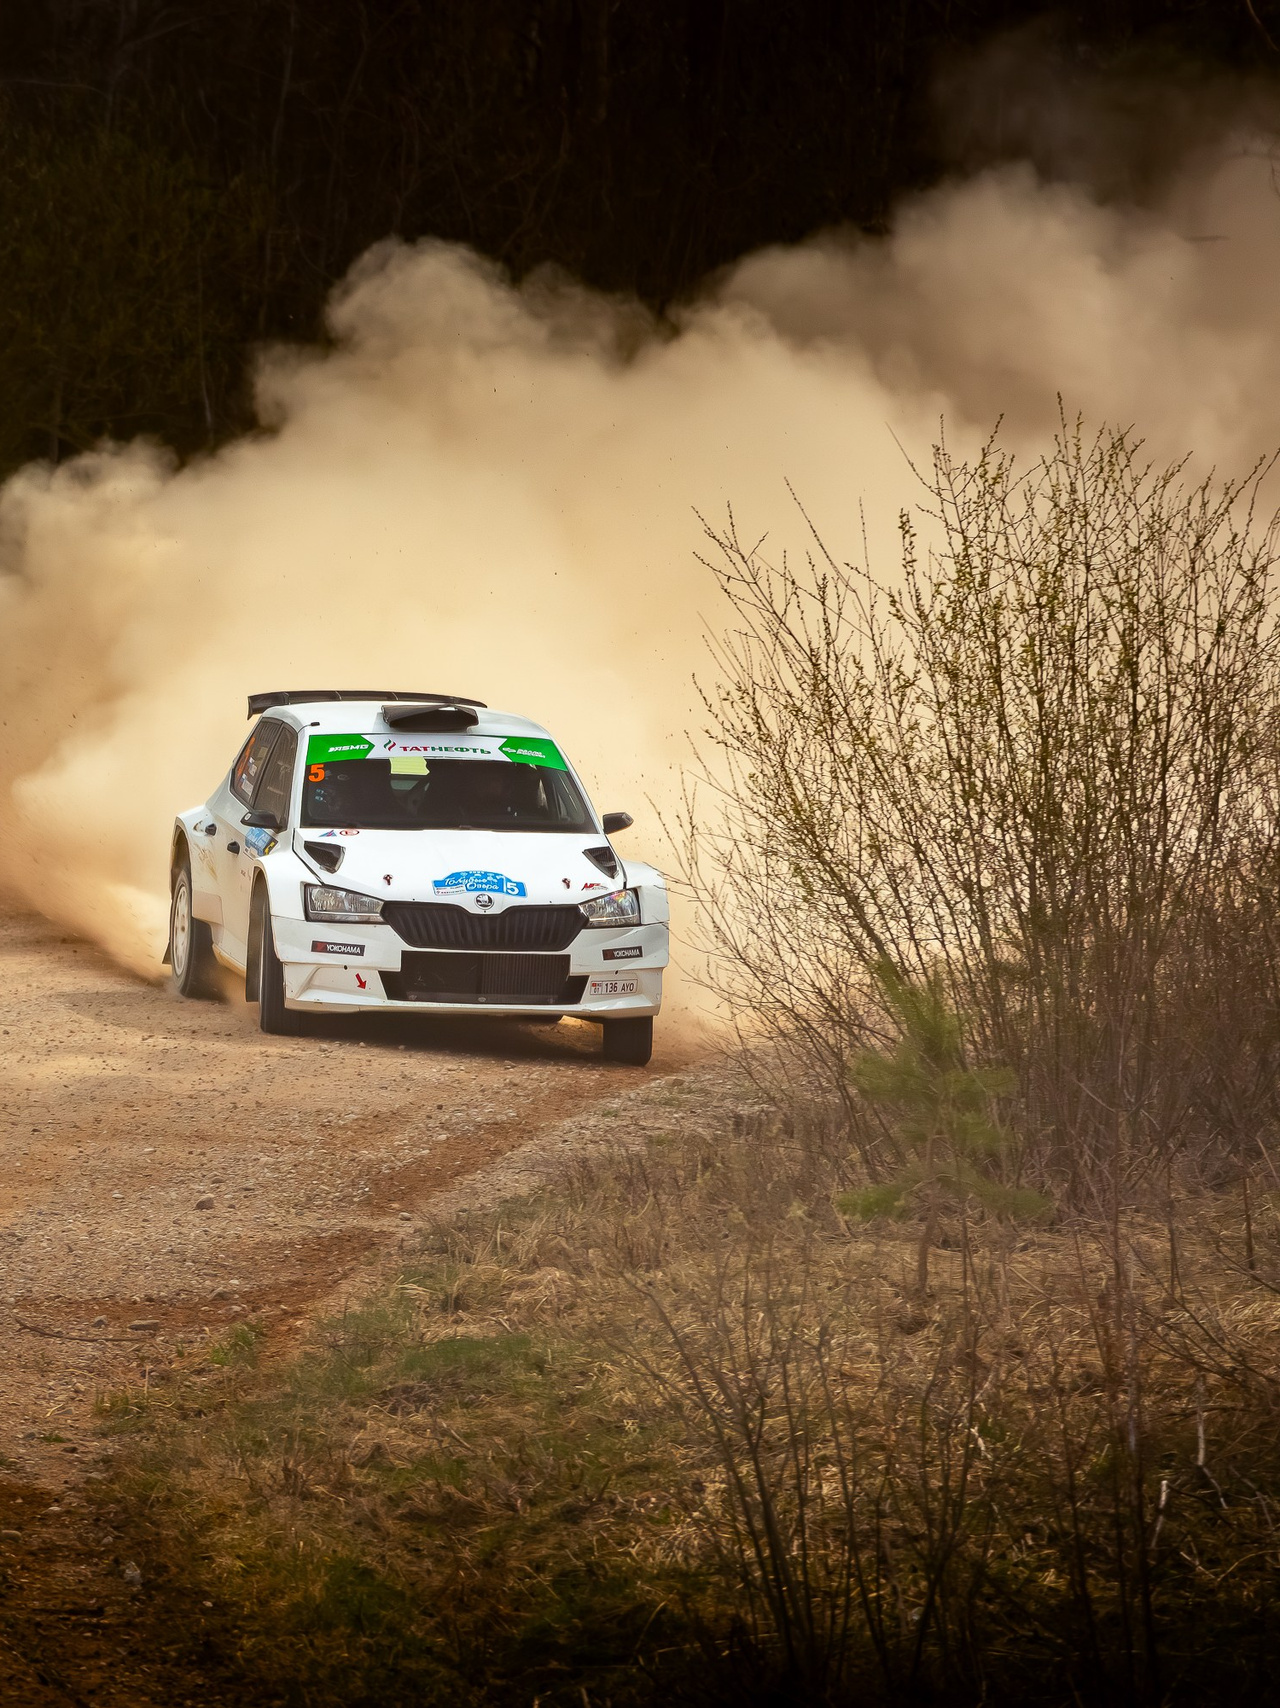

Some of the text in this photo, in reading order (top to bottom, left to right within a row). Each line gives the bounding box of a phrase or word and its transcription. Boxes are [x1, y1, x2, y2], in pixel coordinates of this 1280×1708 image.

[400, 746, 491, 754] ТАТНЕФТЬ
[308, 764, 325, 782] 5
[506, 882, 520, 895] 5
[326, 944, 361, 954] YOKOHAMA
[613, 949, 640, 957] YOKOHAMA
[605, 982, 634, 993] 136 AYO
